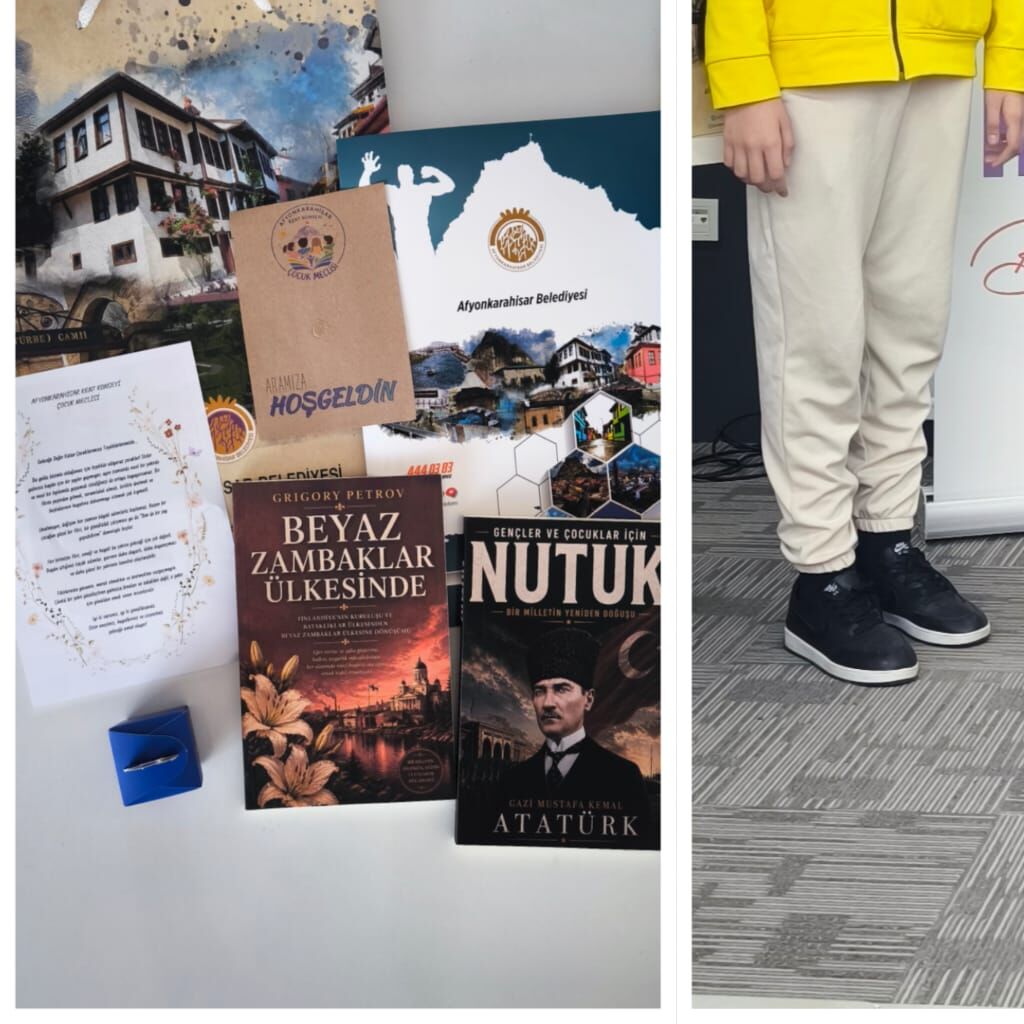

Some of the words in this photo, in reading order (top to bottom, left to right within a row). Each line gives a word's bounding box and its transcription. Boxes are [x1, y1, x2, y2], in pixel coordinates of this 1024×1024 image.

[457, 294, 534, 313] Afyonkarahisar
[536, 288, 588, 304] Belediyesi
[265, 373, 307, 393] ARAMIZA
[270, 378, 398, 418] HOŞGELDİN
[272, 490, 340, 503] GRIGORY
[346, 488, 404, 500] PETROV
[282, 512, 402, 545] BEYAZ
[493, 528, 541, 540] GENÇLER
[546, 528, 559, 539] VE
[563, 529, 620, 542] ÇOCUKLAR
[624, 528, 647, 542] İÇİN
[250, 544, 435, 575] ZAMBAKLAR
[469, 540, 661, 606] NUTUK
[264, 572, 427, 604] ÜLKESİNDE
[508, 798, 533, 809] GAZİ
[537, 799, 584, 810] MUSTAFA
[588, 800, 624, 811] KEMAL
[492, 810, 640, 837] ATATÜRK
